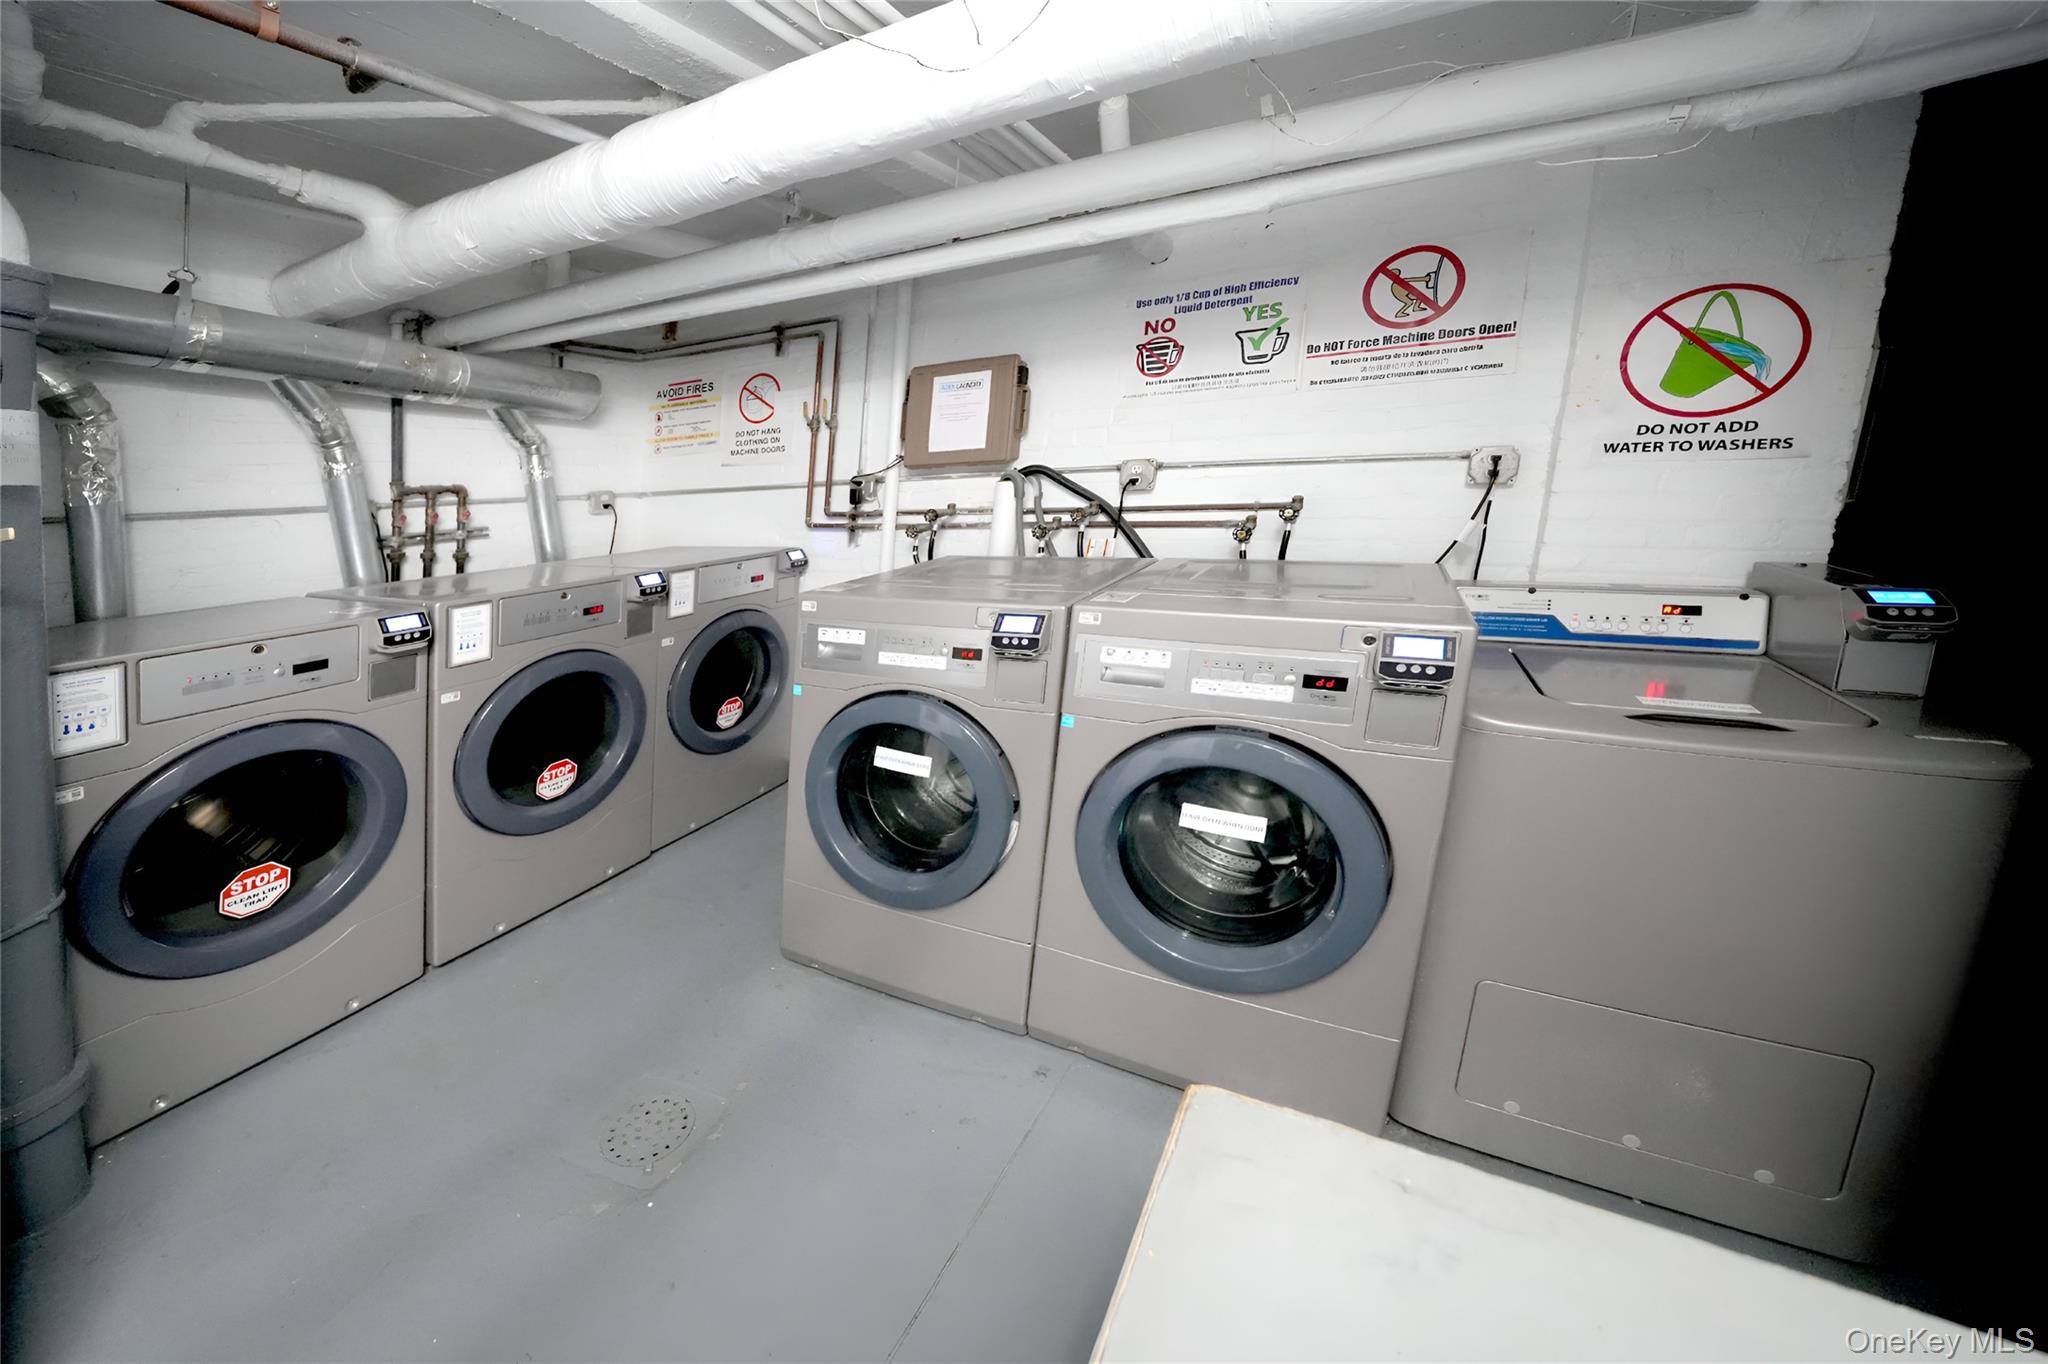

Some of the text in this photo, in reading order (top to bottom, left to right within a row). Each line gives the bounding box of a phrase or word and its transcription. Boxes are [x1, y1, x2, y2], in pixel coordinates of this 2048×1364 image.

[1136, 276, 1300, 309] Use only 1/8 Cup of High Efficiency
[1174, 295, 1253, 315] Liquid Detergent
[1243, 301, 1283, 322] YES
[1144, 317, 1176, 335] NO
[1307, 344, 1321, 354] Do
[1347, 338, 1380, 349] Force
[1382, 331, 1435, 346] Machine
[1438, 326, 1476, 339] Doors
[1478, 320, 1517, 335] Open!
[656, 382, 714, 400] AVOID FIRES
[735, 426, 781, 438] DO NOT HANG
[1636, 420, 1759, 436] DO NOT ADD
[730, 445, 785, 456] MACHINE DOORS
[735, 436, 781, 447] CLOTHING ON
[1603, 437, 1794, 453] WATER TO WASHERS
[721, 701, 741, 715] STOP
[543, 764, 572, 782] STOP
[230, 867, 282, 896] STOP
[226, 883, 283, 907] CLEAN LINT
[244, 895, 268, 908] TRAP
